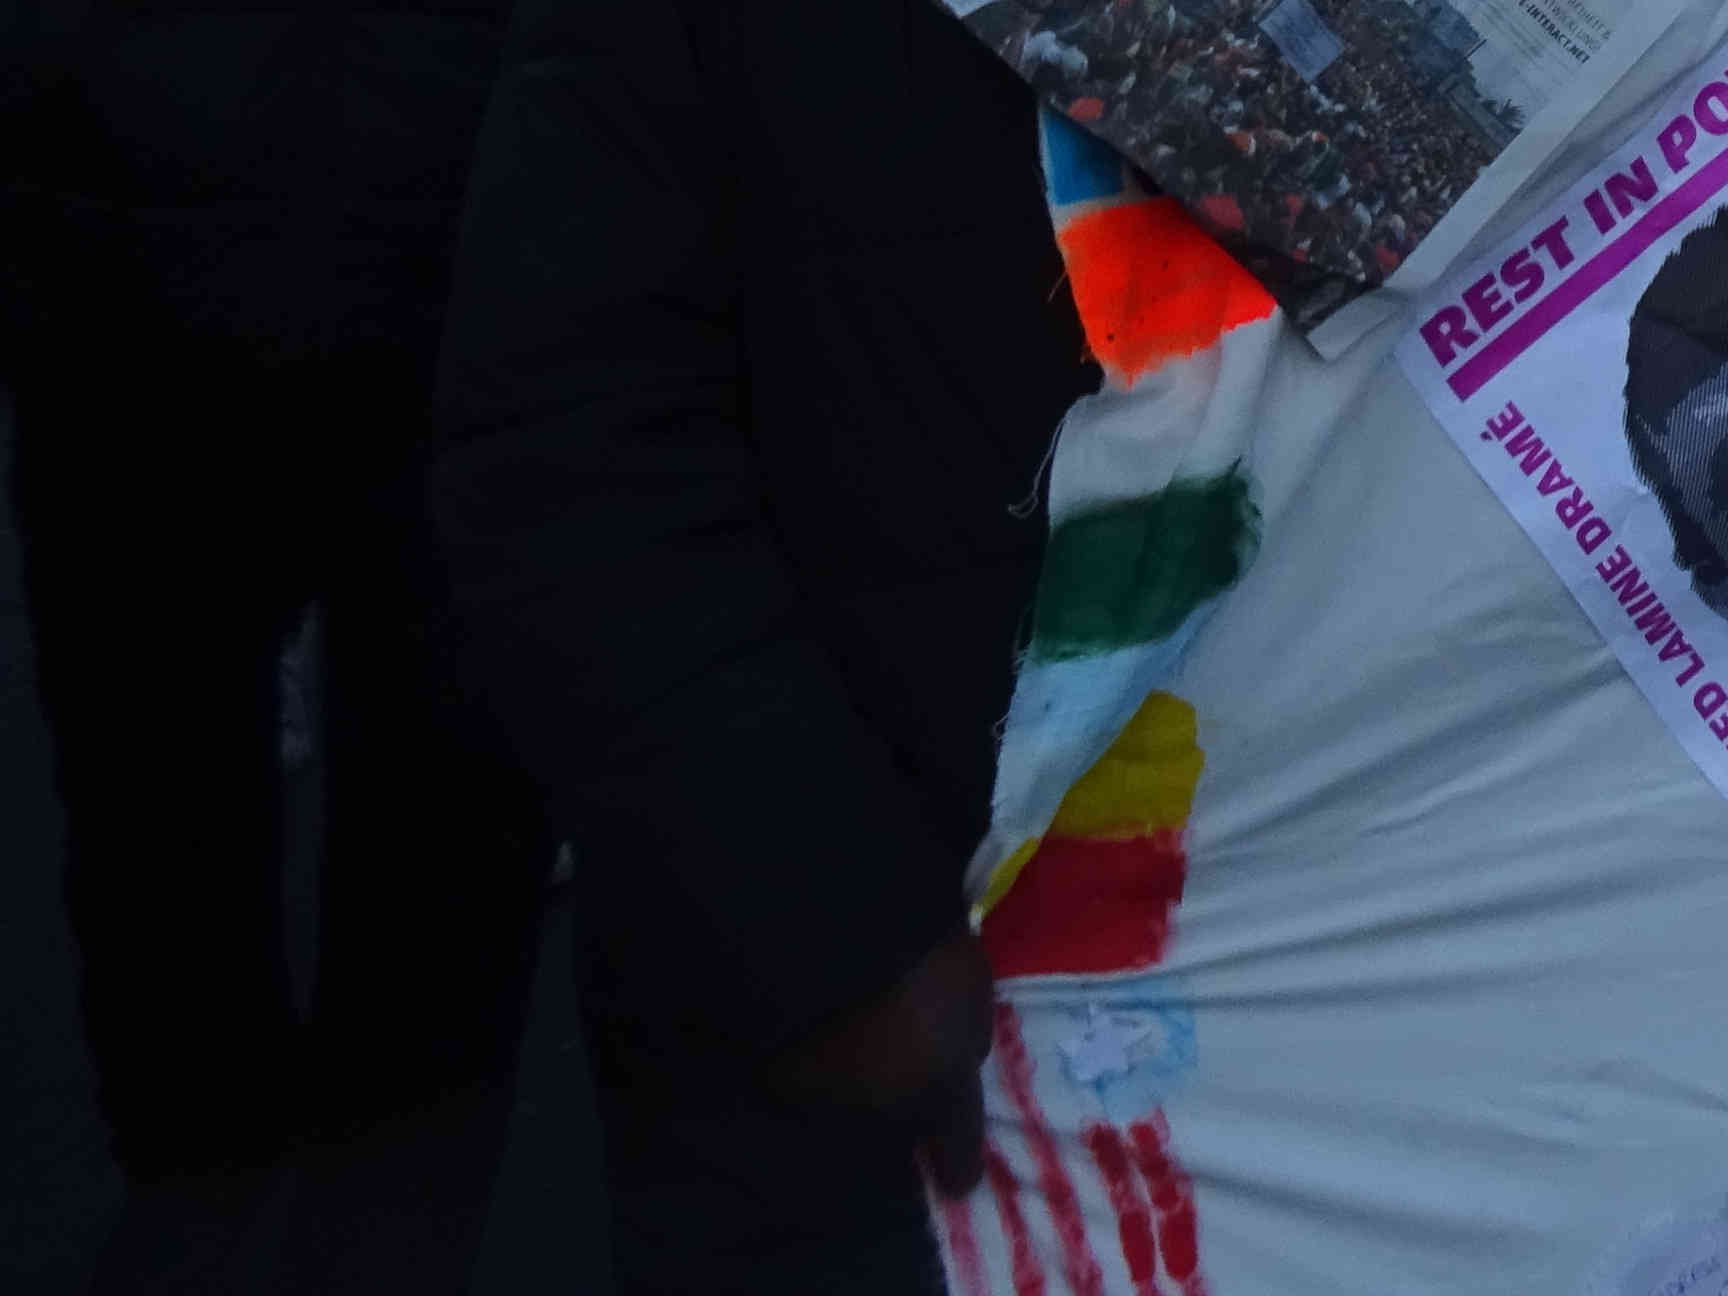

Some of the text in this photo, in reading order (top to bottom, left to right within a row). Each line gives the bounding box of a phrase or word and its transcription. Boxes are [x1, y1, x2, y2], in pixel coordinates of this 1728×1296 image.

[1419, 219, 1575, 368] REST
[1583, 155, 1659, 235] IN
[1480, 400, 1613, 556] DRAMÉ
[1595, 544, 1706, 688] LAMINE
